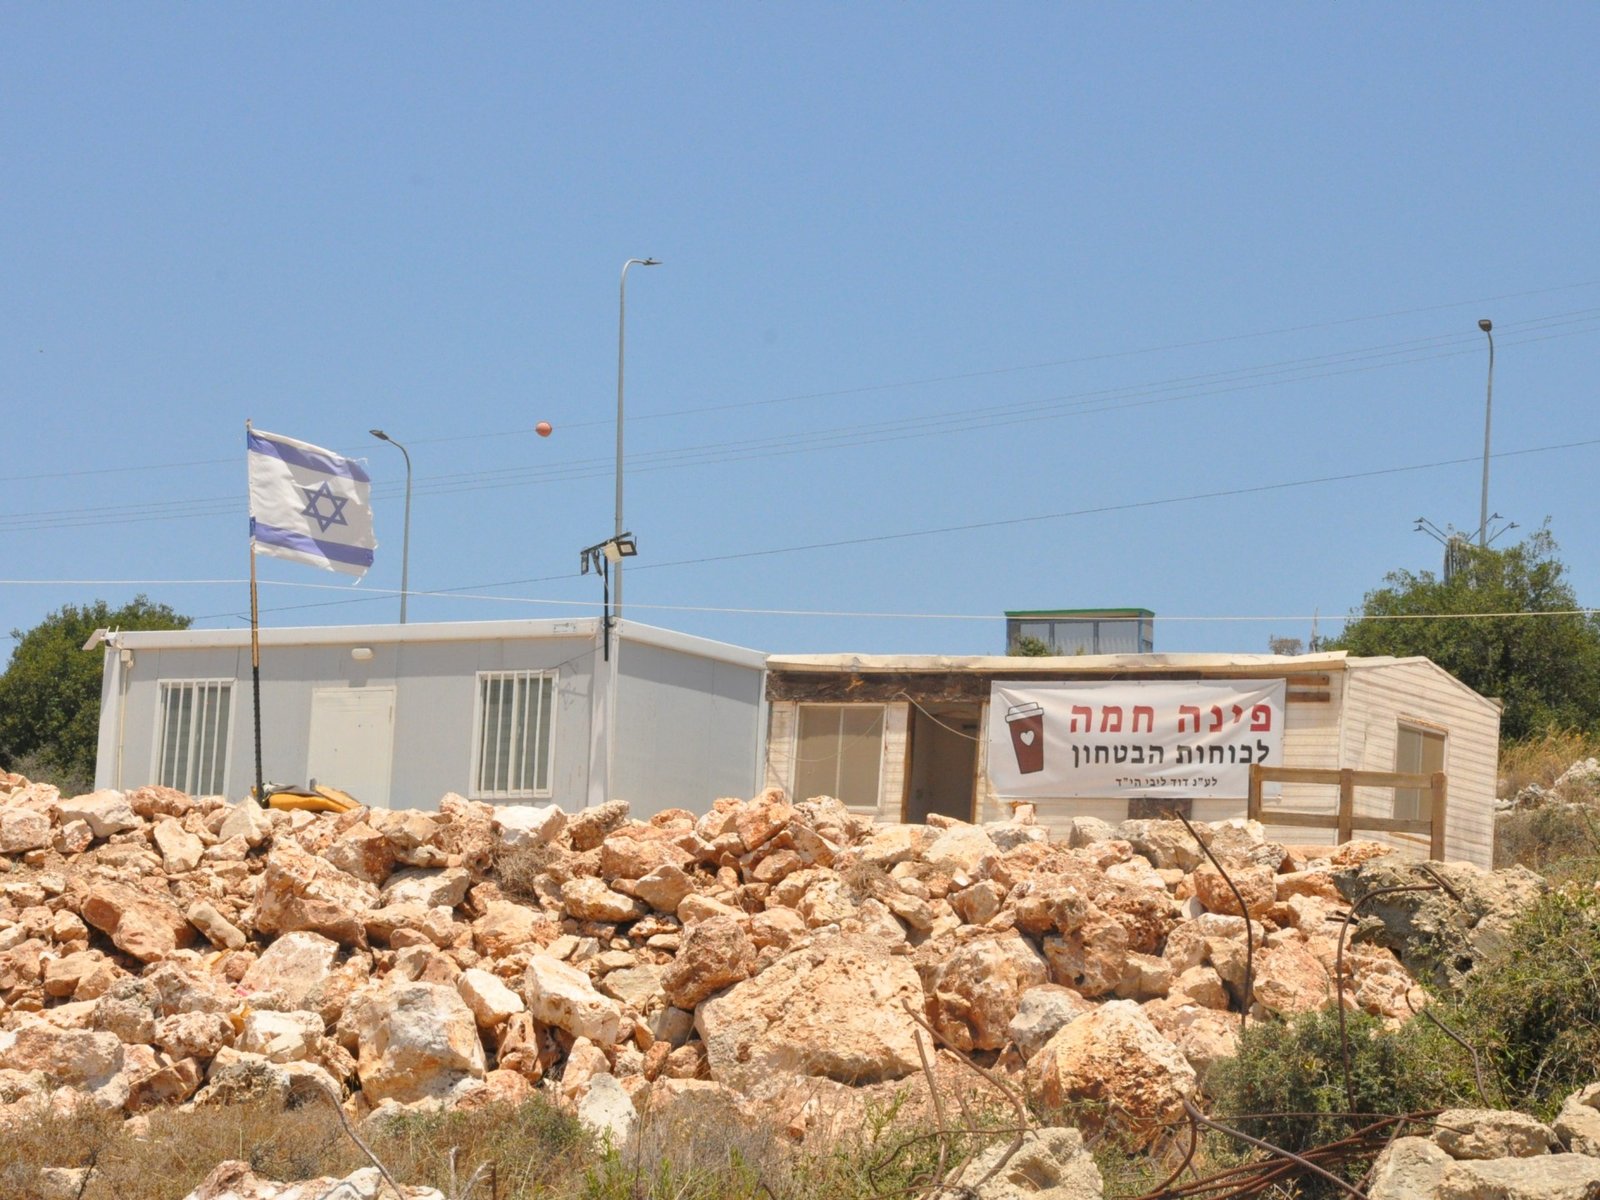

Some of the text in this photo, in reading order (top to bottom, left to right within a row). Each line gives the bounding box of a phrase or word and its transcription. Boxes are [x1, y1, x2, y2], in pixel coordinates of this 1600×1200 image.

[1070, 704, 1271, 733] פינה חמה
[1072, 739, 1270, 768] לכוחות הבטחון
[1146, 776, 1167, 788] ליבי
[1170, 778, 1189, 788] דוד
